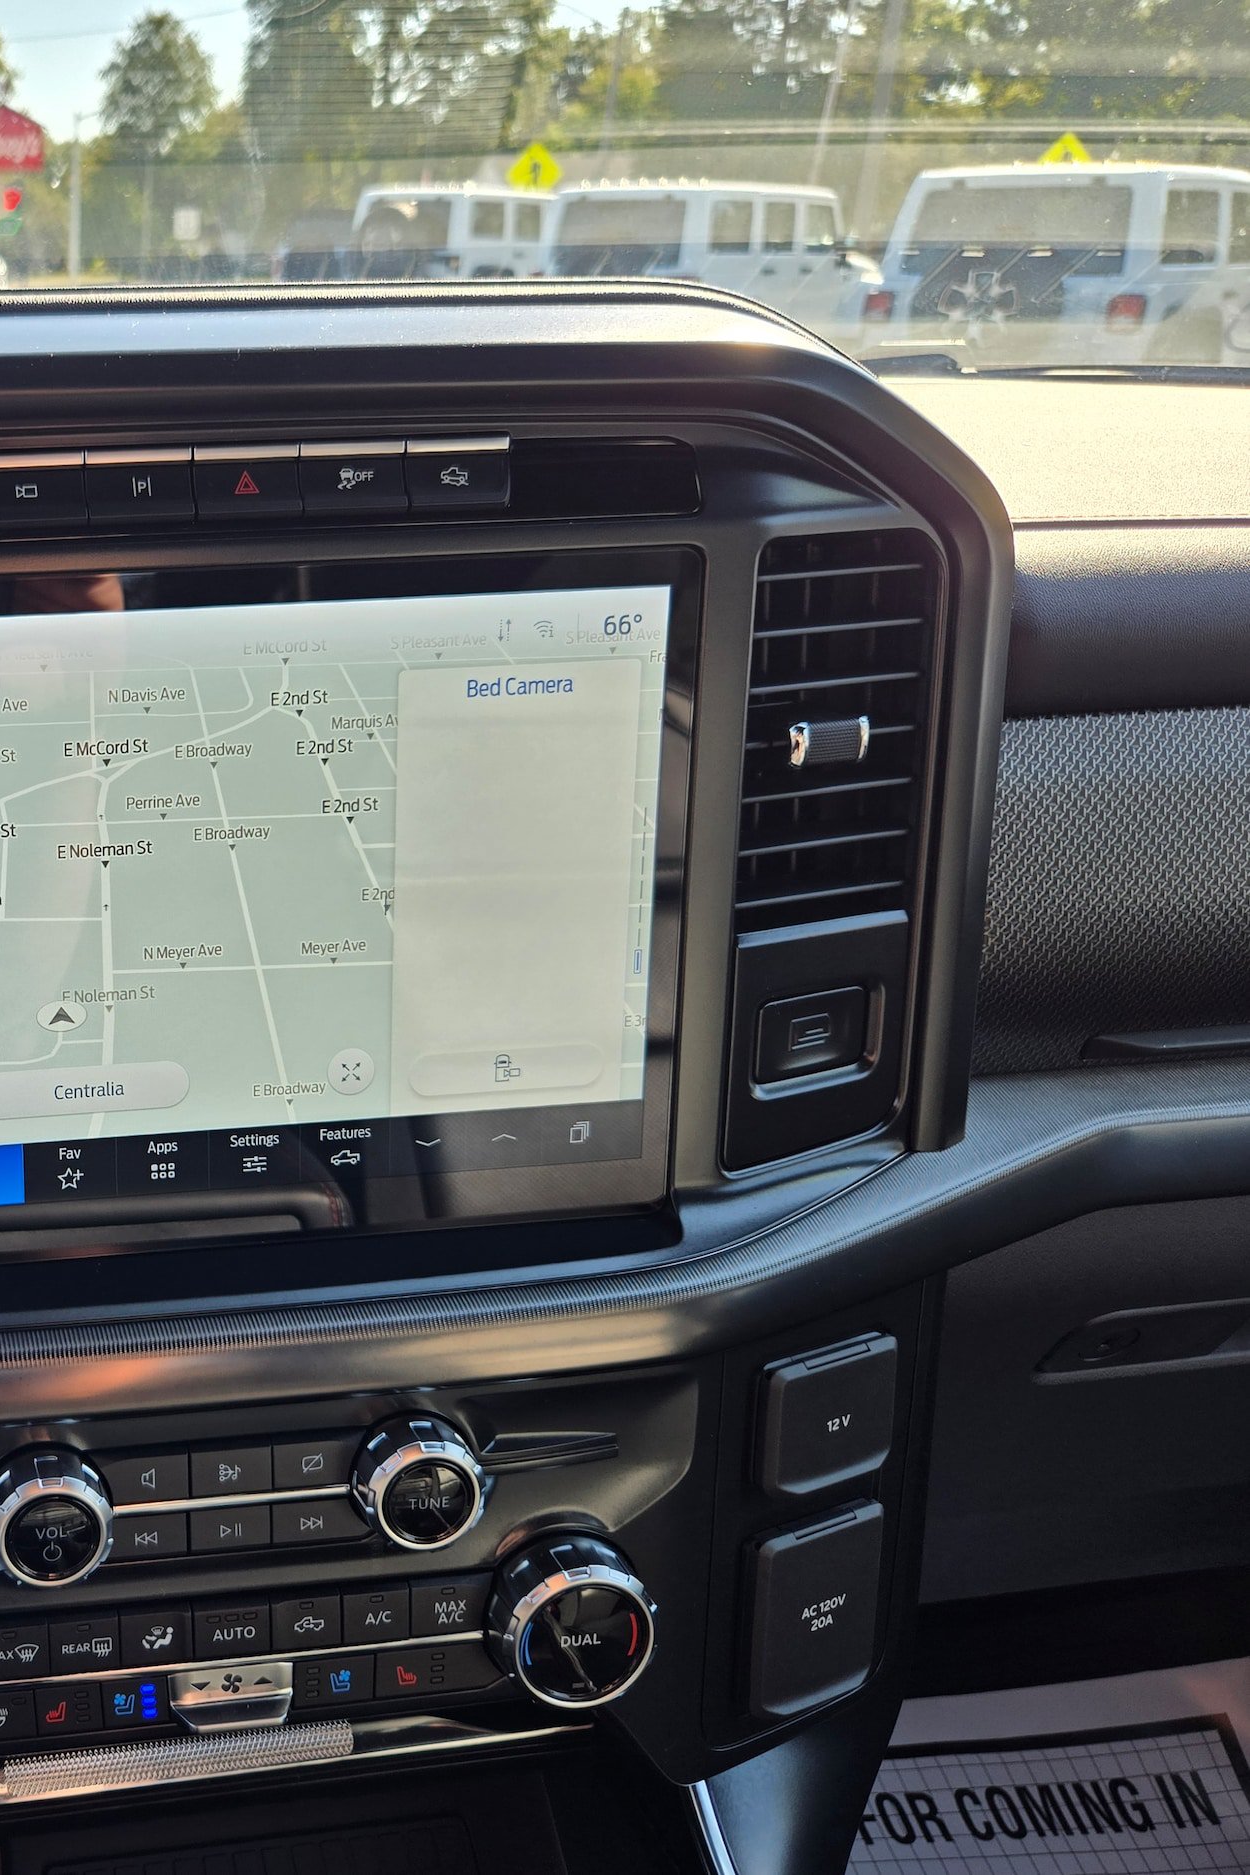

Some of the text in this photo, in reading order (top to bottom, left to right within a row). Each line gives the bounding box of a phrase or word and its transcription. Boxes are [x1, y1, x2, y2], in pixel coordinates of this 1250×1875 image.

[354, 471, 374, 482] OFF
[402, 634, 460, 649] Pleasant
[462, 634, 487, 646] Ave
[108, 688, 186, 703] N Davis Ave
[467, 677, 574, 698] Bed Camera
[2, 698, 28, 712] Ave
[270, 690, 328, 706] E 2nd St
[331, 716, 382, 731] Marquis
[64, 739, 148, 756] E McCord St
[175, 742, 252, 758] E Broadway
[296, 738, 353, 755] E 2nd St
[1, 749, 16, 762] St
[126, 794, 200, 810] Perrine Ave
[322, 798, 378, 814] E 2nd St
[0, 823, 16, 838] St
[194, 826, 270, 841] E Broadway
[58, 840, 153, 859] E Noleman St
[362, 888, 370, 901] E
[144, 944, 222, 961] N Meyer Ave
[301, 939, 366, 957] Meyer Ave
[74, 988, 138, 1004] Noleman
[140, 985, 156, 1000] St
[54, 1080, 124, 1100] Centralia
[253, 1081, 326, 1097] E Broadway
[230, 1132, 280, 1150] Settings
[320, 1126, 372, 1142] Features
[58, 1146, 82, 1162] Fav
[147, 1140, 178, 1156] Apps
[826, 1414, 851, 1433] 12 V
[408, 1494, 450, 1512] TUNE
[35, 1525, 68, 1540] VOL
[434, 1599, 466, 1614] MAX
[802, 1594, 847, 1620] AC 120V
[364, 1610, 392, 1626] A/C
[437, 1610, 464, 1626] A/C
[810, 1614, 834, 1632] 20A
[212, 1626, 256, 1642] AUTO
[560, 1632, 602, 1648] DUAL
[61, 1640, 91, 1656] REAR
[953, 1777, 1156, 1842] COMING
[1155, 1769, 1222, 1831] IN
